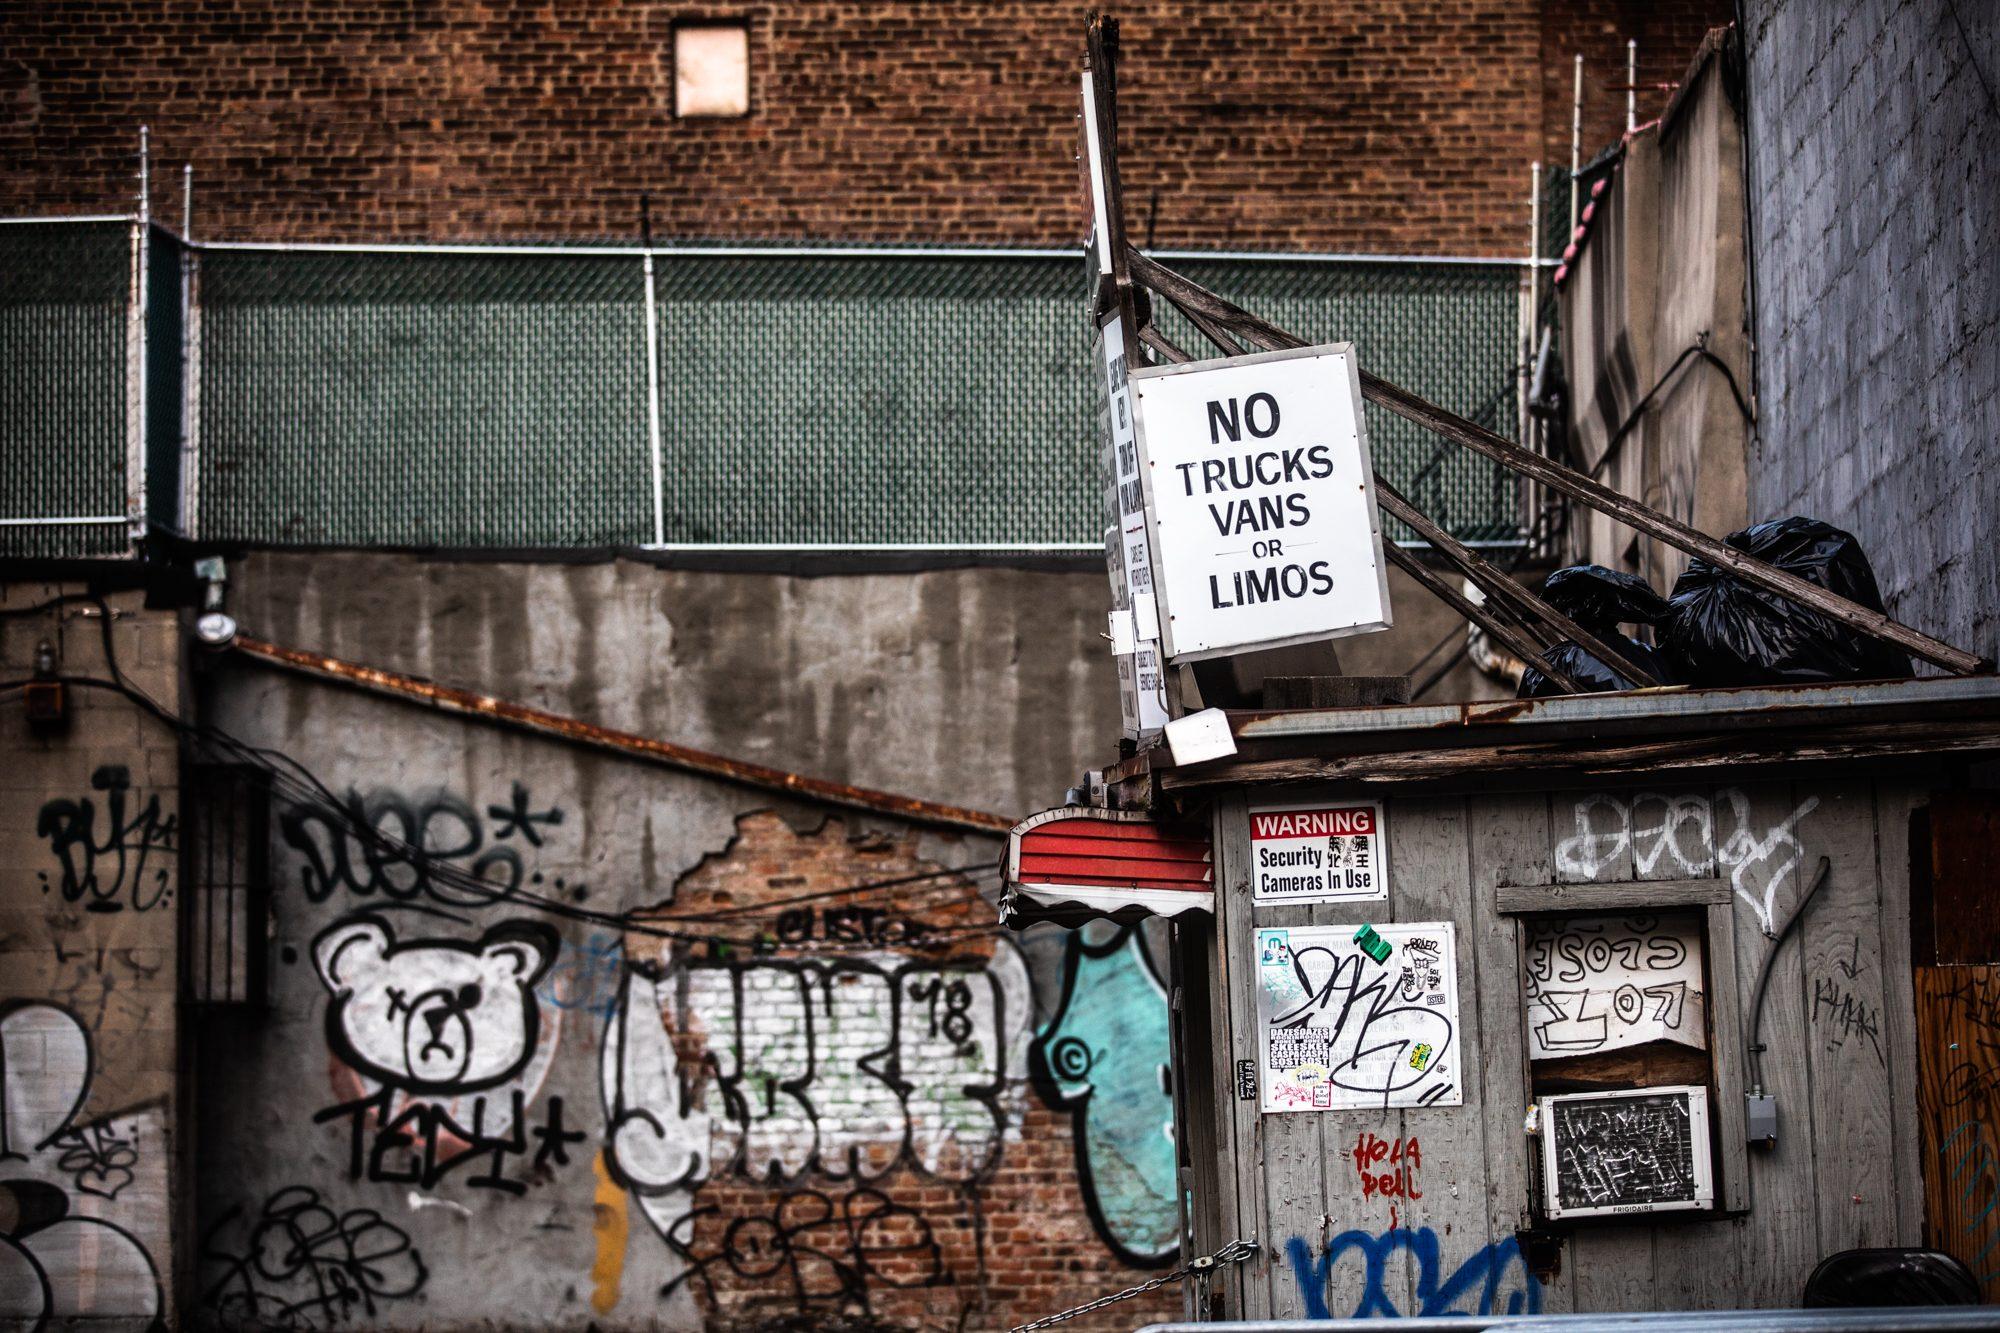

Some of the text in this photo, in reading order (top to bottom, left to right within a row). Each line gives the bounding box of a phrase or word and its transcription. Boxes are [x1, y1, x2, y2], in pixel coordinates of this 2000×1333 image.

[1206, 391, 1281, 445] NO
[1175, 445, 1334, 497] TRUCKS
[1208, 492, 1311, 537] VANS
[1252, 538, 1284, 559] OR
[1209, 560, 1334, 610] LIMOS
[1256, 811, 1369, 837] WARNING
[1260, 845, 1322, 869] Security
[1261, 868, 1371, 893] Cameras In Use
[1533, 980, 1687, 1051] LOT
[1270, 1050, 1299, 1058] CASPA
[1300, 1050, 1329, 1058] CASPA
[1613, 1205, 1654, 1213] FRIGIDAIRE
